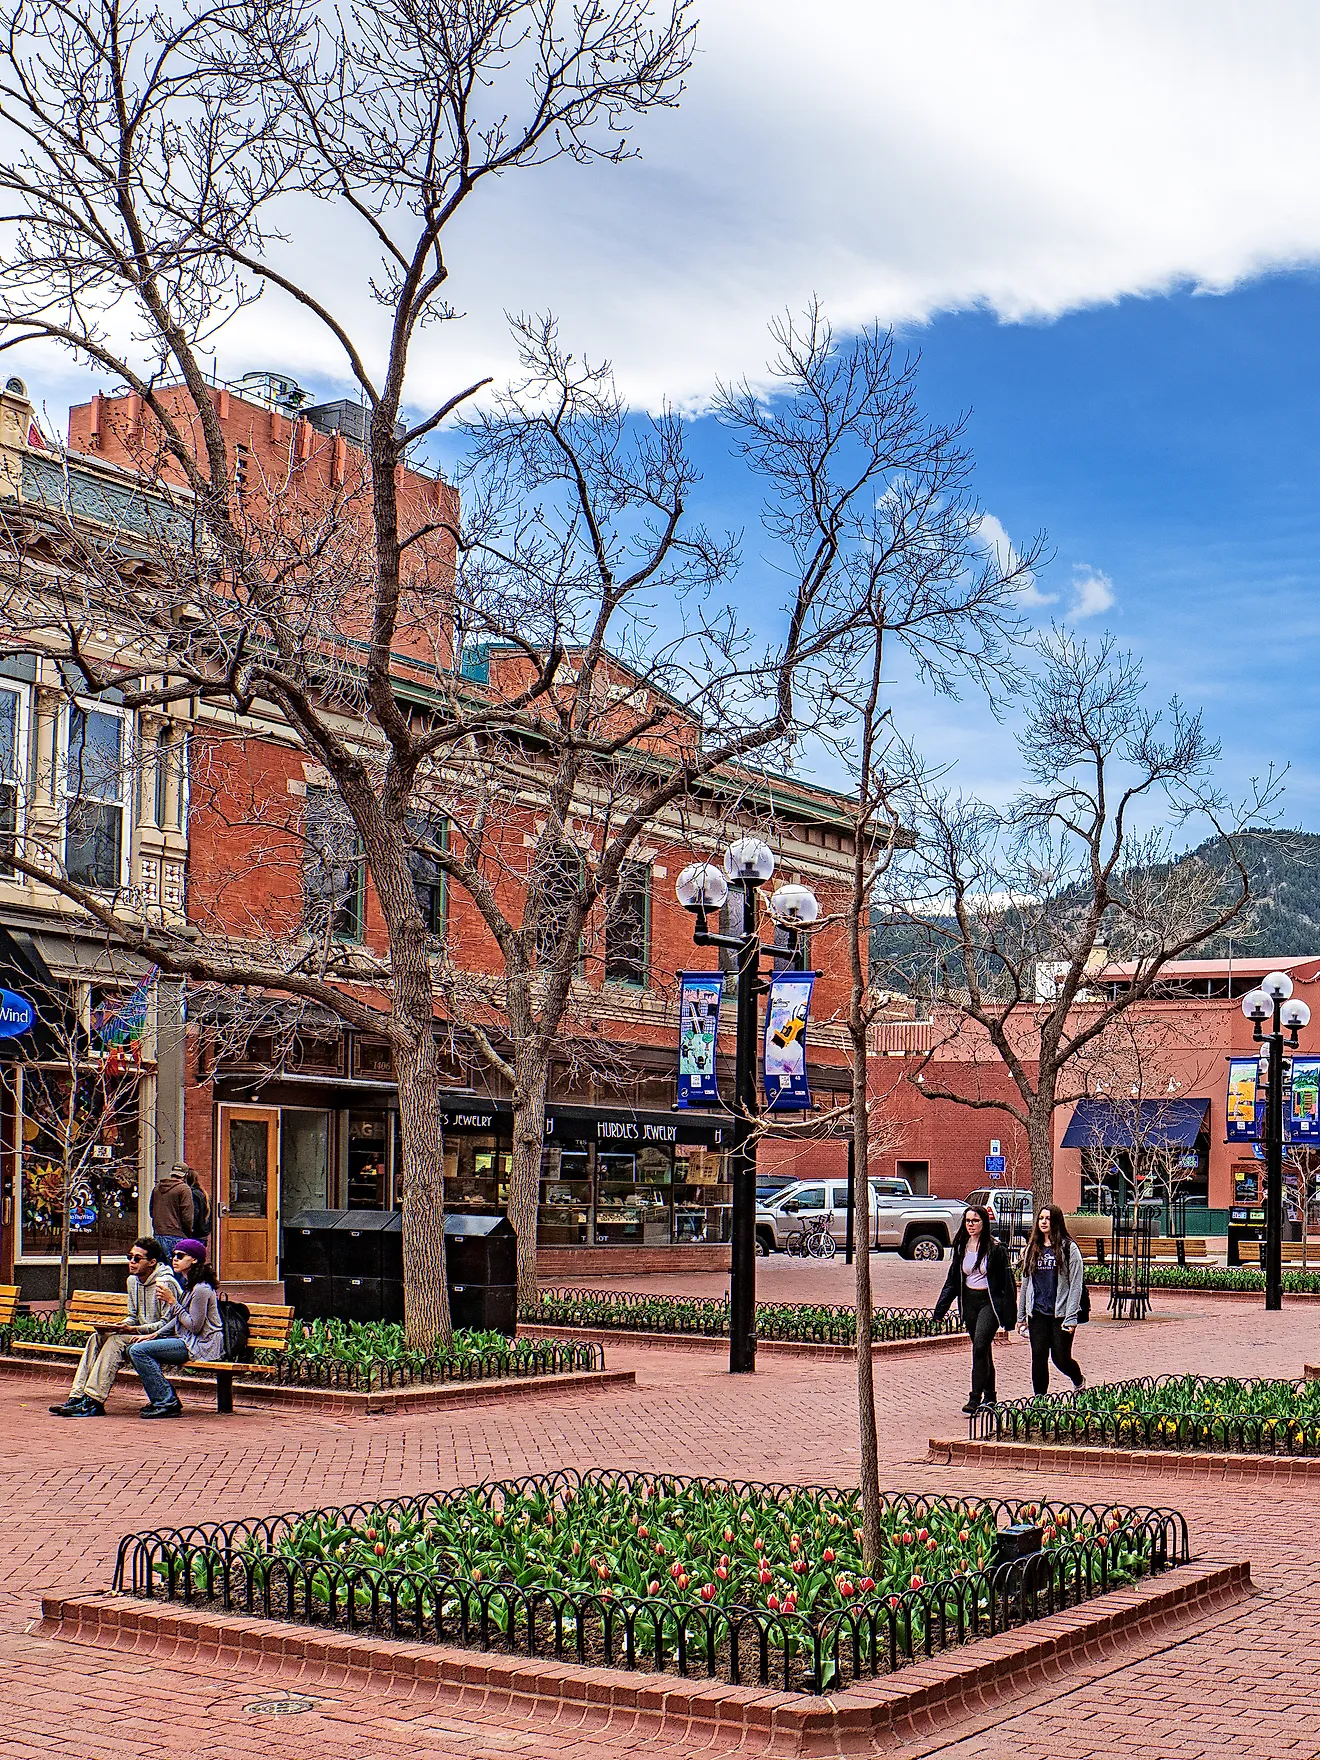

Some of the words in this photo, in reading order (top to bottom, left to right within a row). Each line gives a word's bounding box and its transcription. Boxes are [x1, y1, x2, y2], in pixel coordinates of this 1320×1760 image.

[0, 1007, 29, 1023] Wind
[452, 1114, 493, 1127] JEWELRY
[597, 1121, 639, 1139] HURDLE'S
[642, 1125, 678, 1141] JEWELRY
